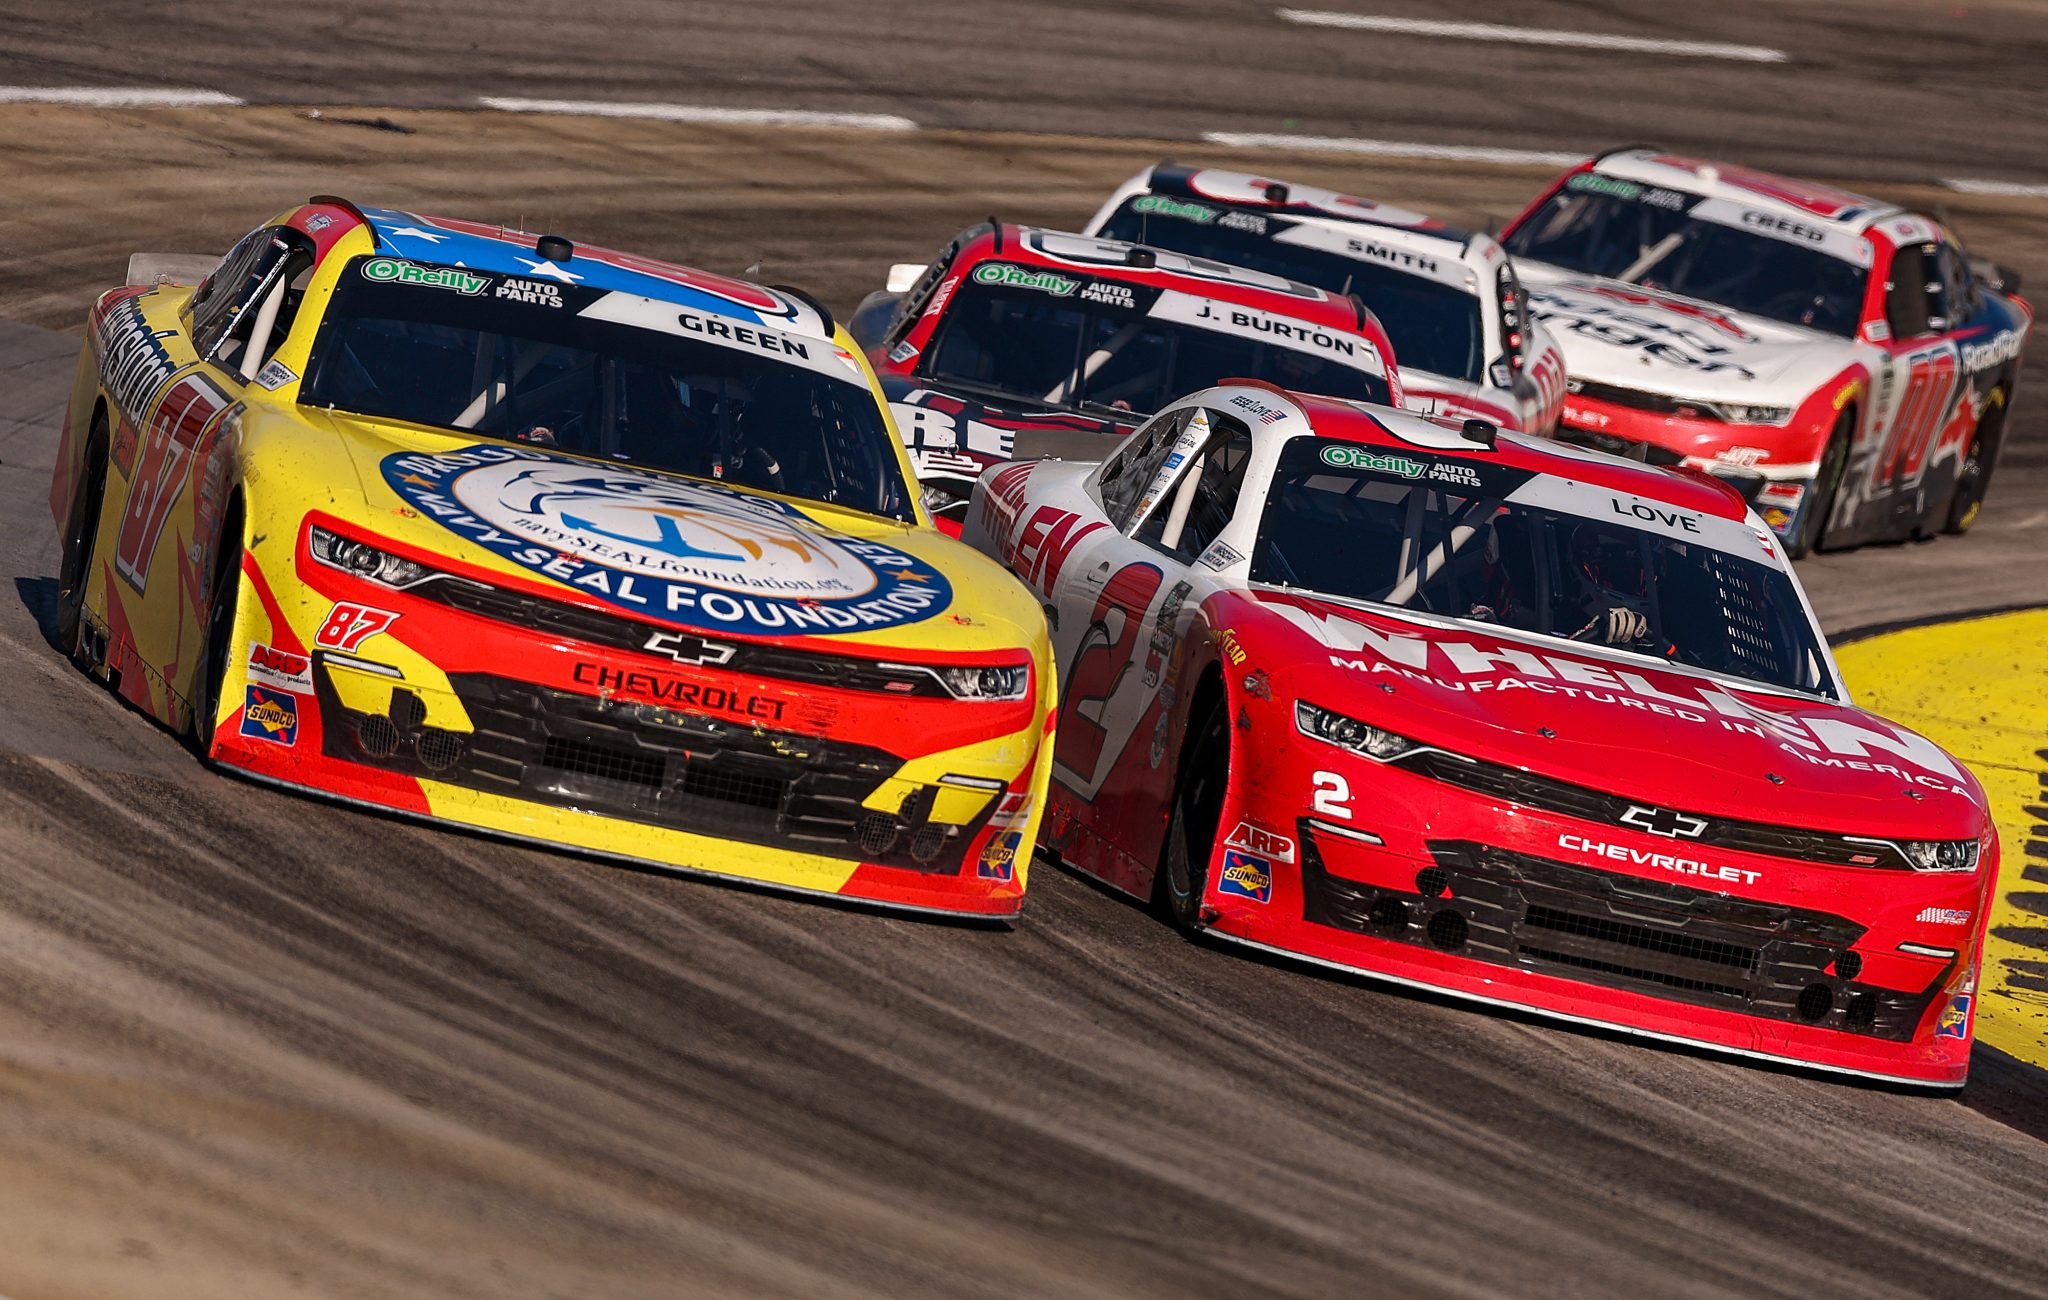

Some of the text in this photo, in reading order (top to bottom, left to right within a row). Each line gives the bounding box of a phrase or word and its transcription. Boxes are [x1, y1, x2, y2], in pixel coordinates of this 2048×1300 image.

[1741, 210, 1825, 242] CREED
[1347, 238, 1438, 273] SMITH
[365, 258, 487, 295] O'Reilly
[503, 278, 559, 296] AUTO
[977, 264, 1075, 295] O'Reilly
[1087, 282, 1132, 298] AUTO
[495, 286, 563, 308] PARTS
[1080, 289, 1135, 308] PARTS
[678, 313, 809, 361] GREEN
[1196, 305, 1354, 357] J. BURTON
[1324, 445, 1427, 478] O'Reilly
[1428, 470, 1481, 487] PARTS
[1433, 462, 1476, 478] AUTO
[116, 372, 236, 598] 87
[1611, 498, 1701, 534] LOVE
[406, 486, 523, 546] NAVY
[511, 547, 647, 605] SEAL
[666, 581, 944, 629] FOUNDATION
[315, 600, 404, 653] 87
[250, 644, 309, 676] ARP
[573, 661, 788, 722] CHEVROLET
[1052, 560, 1164, 804] 2
[1256, 600, 1968, 785] WHELEN
[249, 706, 294, 727] SUNOCO
[1329, 655, 1979, 807] MANUFACTURED IN AMERICA
[1312, 770, 1353, 821] 2
[1227, 824, 1292, 857] ARP
[1558, 833, 1763, 886] CHEVROLET
[1226, 868, 1269, 887] SUNOCO
